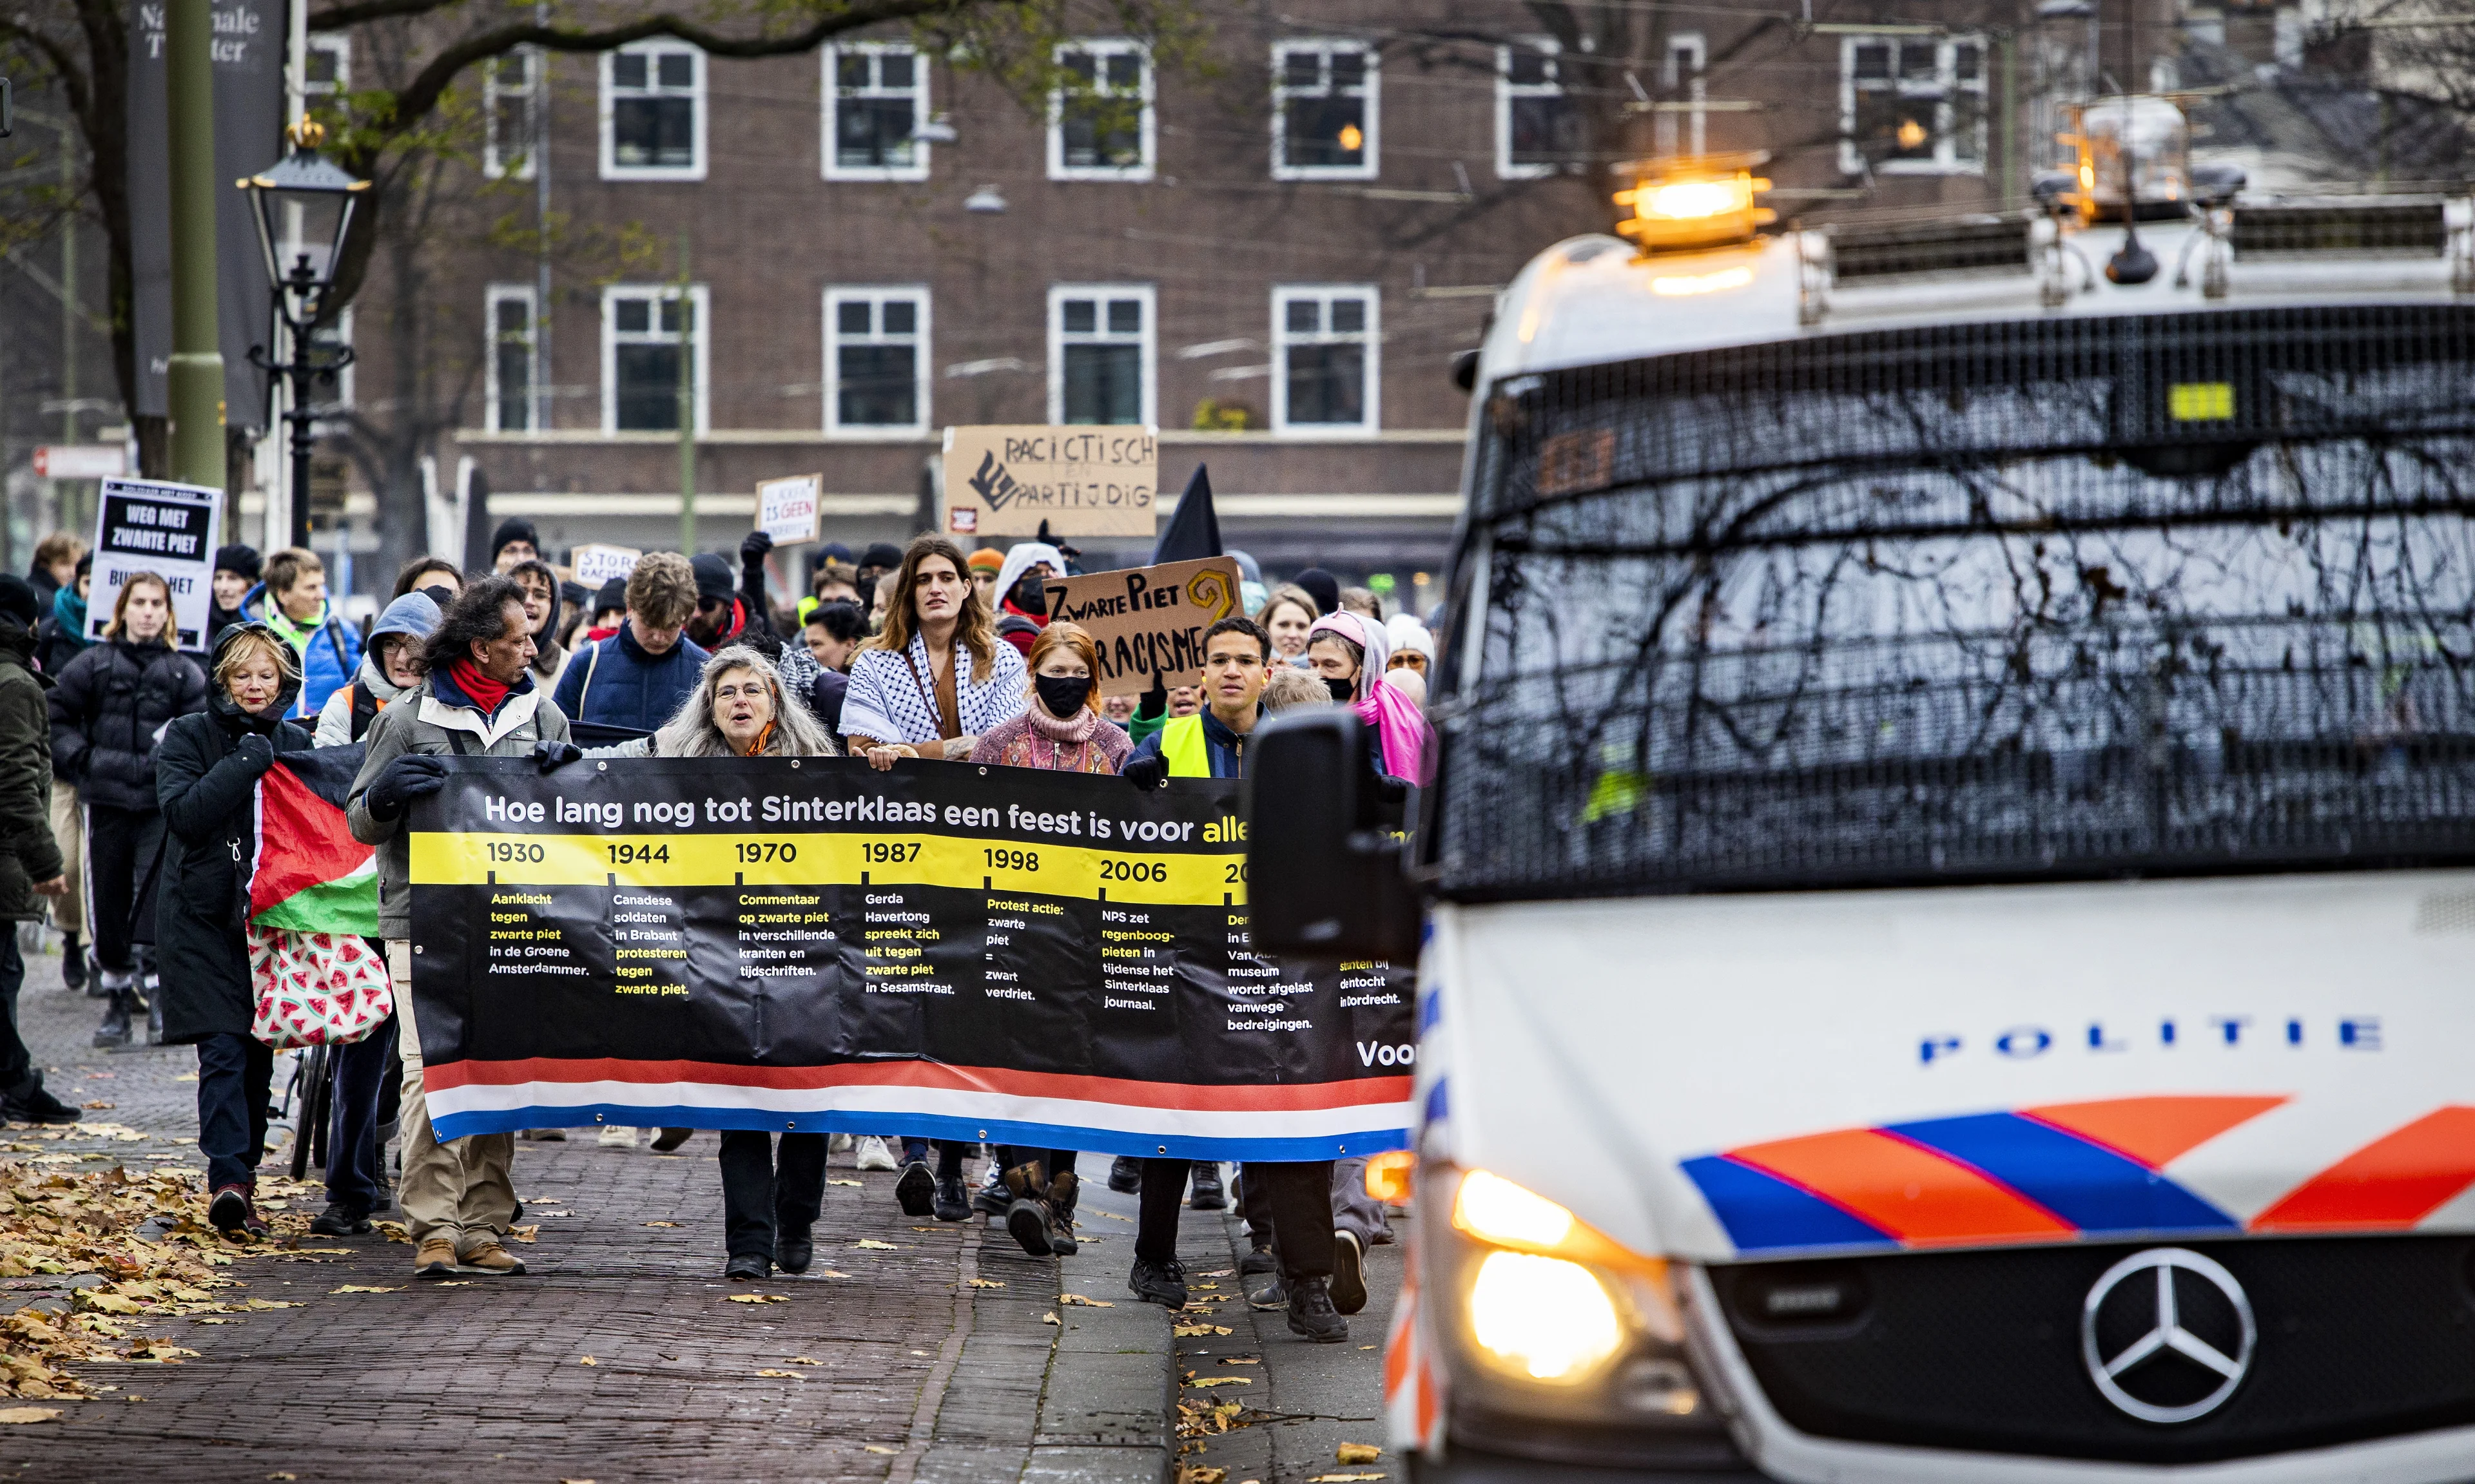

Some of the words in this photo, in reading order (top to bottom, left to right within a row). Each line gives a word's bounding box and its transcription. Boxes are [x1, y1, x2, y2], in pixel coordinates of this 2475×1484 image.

[139, 4, 259, 34] Nanale
[145, 33, 246, 61] Tter
[126, 503, 157, 526] WEG
[159, 507, 189, 529] MET
[766, 506, 778, 521] IS
[781, 500, 813, 519] GEEN
[112, 526, 166, 551] ZWARTE
[168, 533, 198, 554] PIET
[169, 576, 193, 593] HET
[1094, 626, 1205, 680] RACISME
[485, 795, 545, 824] Hoe
[556, 796, 623, 828] lang
[634, 802, 695, 827] nog
[705, 796, 752, 822] tot
[761, 795, 937, 822] Sinterklaas
[944, 805, 999, 827] een
[1008, 804, 1082, 835] feest
[1089, 811, 1111, 838] is
[1120, 820, 1194, 842] voor
[487, 842, 545, 863] 1930
[607, 844, 670, 864] 1944
[735, 843, 797, 863] 1970
[862, 843, 922, 863] 1987
[984, 848, 1039, 872] 1998
[1100, 860, 1167, 883] 2006
[491, 892, 553, 906] Aanklacht
[613, 894, 673, 907] Canadese
[739, 894, 820, 905] Commentaar
[865, 892, 904, 905] Gerda
[987, 898, 1029, 912] Protest
[1031, 903, 1064, 915] actie:
[490, 912, 528, 924] tegen
[614, 911, 666, 923] soldaten
[739, 914, 755, 925] op
[758, 912, 800, 923] zwarte
[804, 912, 830, 925] piet
[865, 911, 930, 924] Havertong
[1102, 910, 1127, 923] NPS
[1129, 913, 1150, 923] zet
[987, 918, 1025, 929] zwarte
[490, 930, 534, 940] zwarte
[536, 929, 561, 941] piet
[615, 929, 626, 941] in
[630, 929, 678, 941] Brabant
[739, 930, 750, 941] in
[753, 929, 835, 941] verschillende
[864, 928, 913, 941] spreekt
[915, 928, 940, 940] zich
[985, 934, 1009, 947] piet
[1102, 930, 1175, 943] regenboog-
[1228, 932, 1239, 943] in
[490, 946, 500, 956] in
[504, 946, 519, 957] de
[524, 947, 570, 958] Groene
[616, 947, 688, 961] protesteren
[738, 947, 786, 959] kranten
[789, 950, 805, 959] en
[865, 946, 882, 958] uit
[885, 947, 922, 959] tegen
[1102, 946, 1140, 958] pieten
[1143, 947, 1156, 958] in
[1227, 950, 1252, 961] Van
[489, 963, 590, 976] Amsterdammer.
[616, 966, 652, 979] tegen
[739, 965, 817, 979] tijdschriften.
[865, 964, 908, 976] zwarte
[911, 963, 935, 976] piet
[1102, 963, 1150, 976] tijdense
[1153, 965, 1174, 976] het
[1228, 967, 1279, 977] museum
[985, 971, 1018, 982] zwart
[615, 984, 658, 994] zwarte
[661, 983, 689, 996] piet.
[866, 982, 877, 993] in
[880, 981, 955, 995] Sesamstraat.
[1105, 979, 1170, 994] Sinterklaas
[1226, 983, 1266, 996] wordt
[1268, 981, 1314, 996] afgelast
[985, 987, 1036, 1001] verdriet.
[1103, 996, 1156, 1010] journaal.
[1227, 1003, 1285, 1014] vanwege
[1227, 1018, 1313, 1032] bedreigingen.
[1917, 1015, 2383, 1066] POLITIE
[1356, 1040, 1418, 1067] Voo
